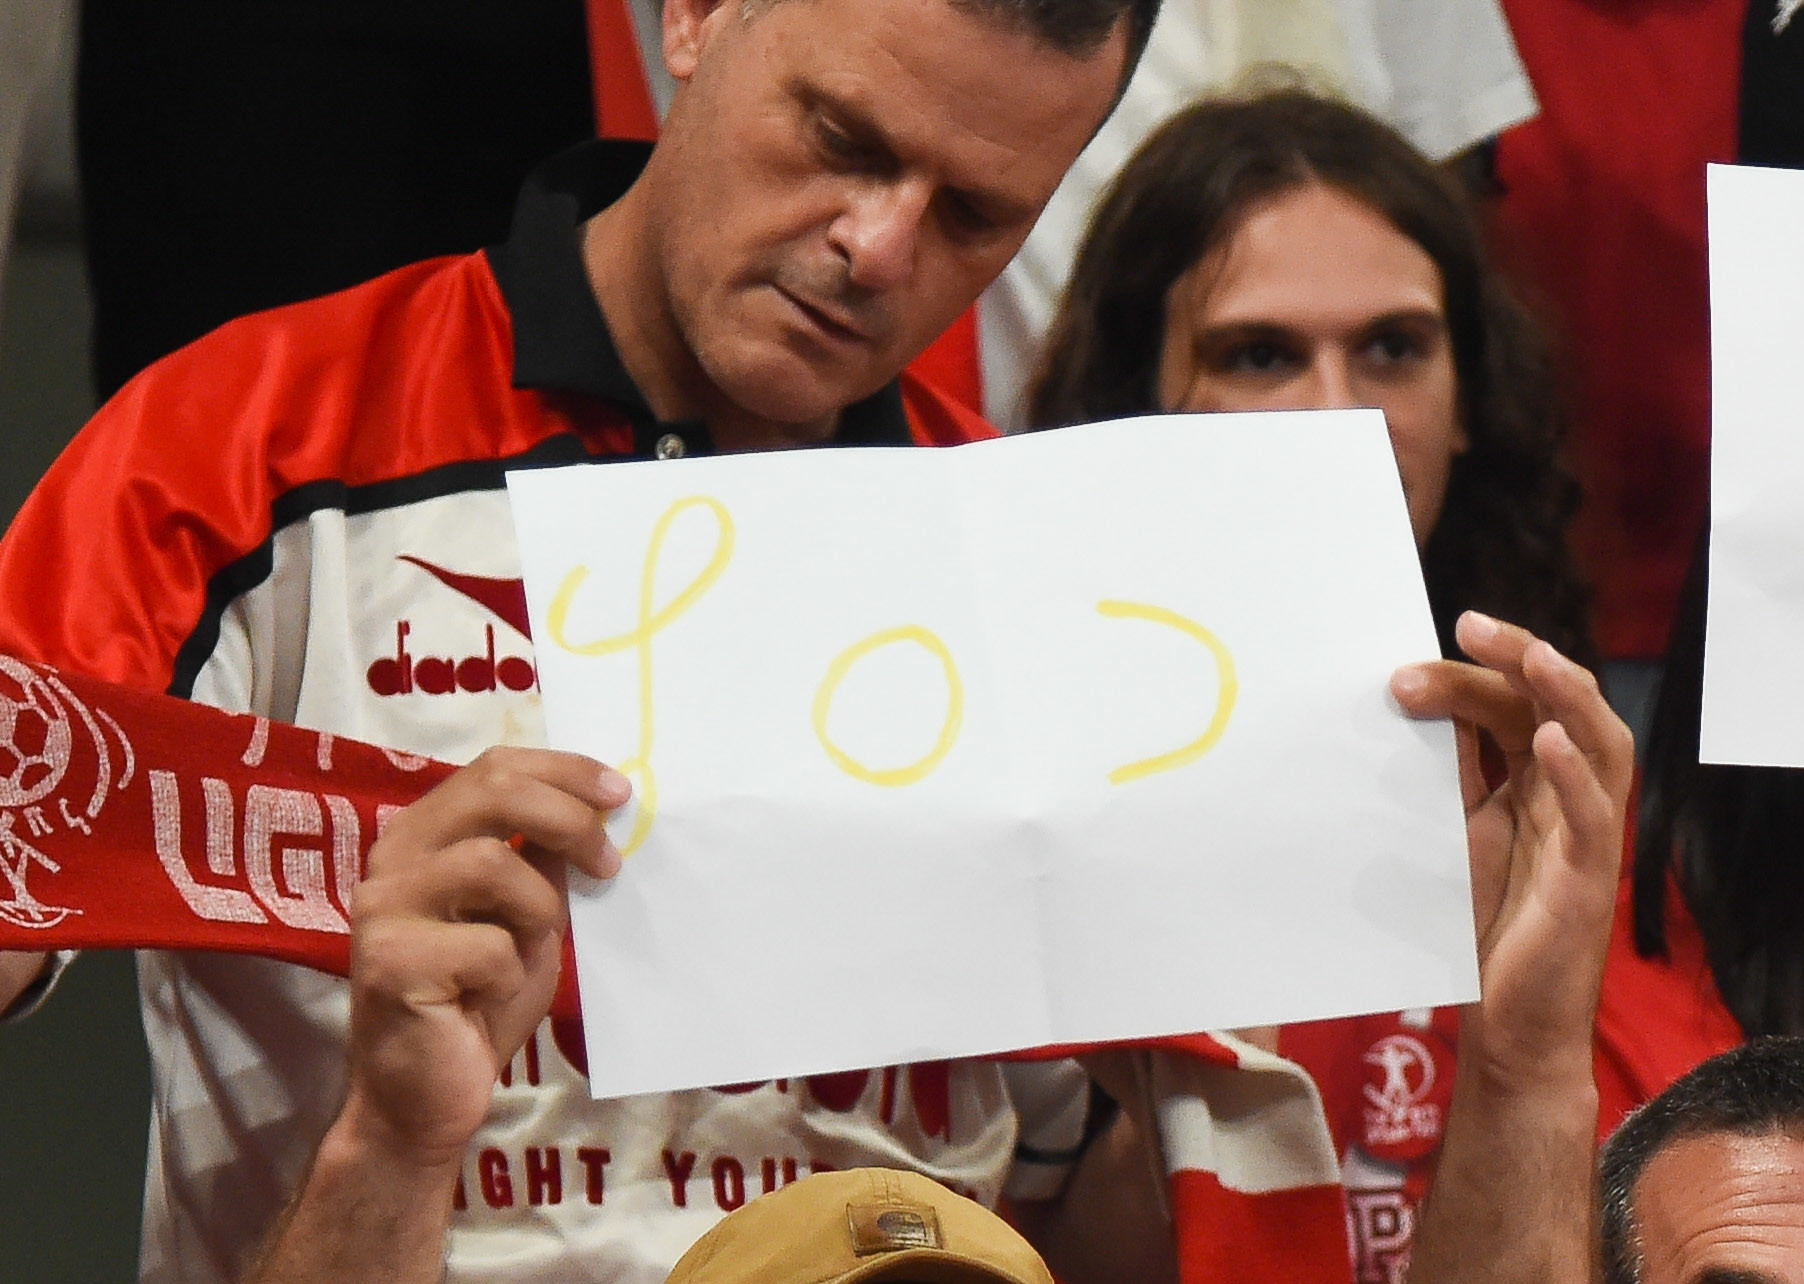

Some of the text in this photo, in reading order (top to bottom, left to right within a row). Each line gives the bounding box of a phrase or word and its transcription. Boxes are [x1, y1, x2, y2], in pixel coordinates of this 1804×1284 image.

[366, 619, 541, 696] diado
[452, 1145, 834, 1212] GHT YOU
